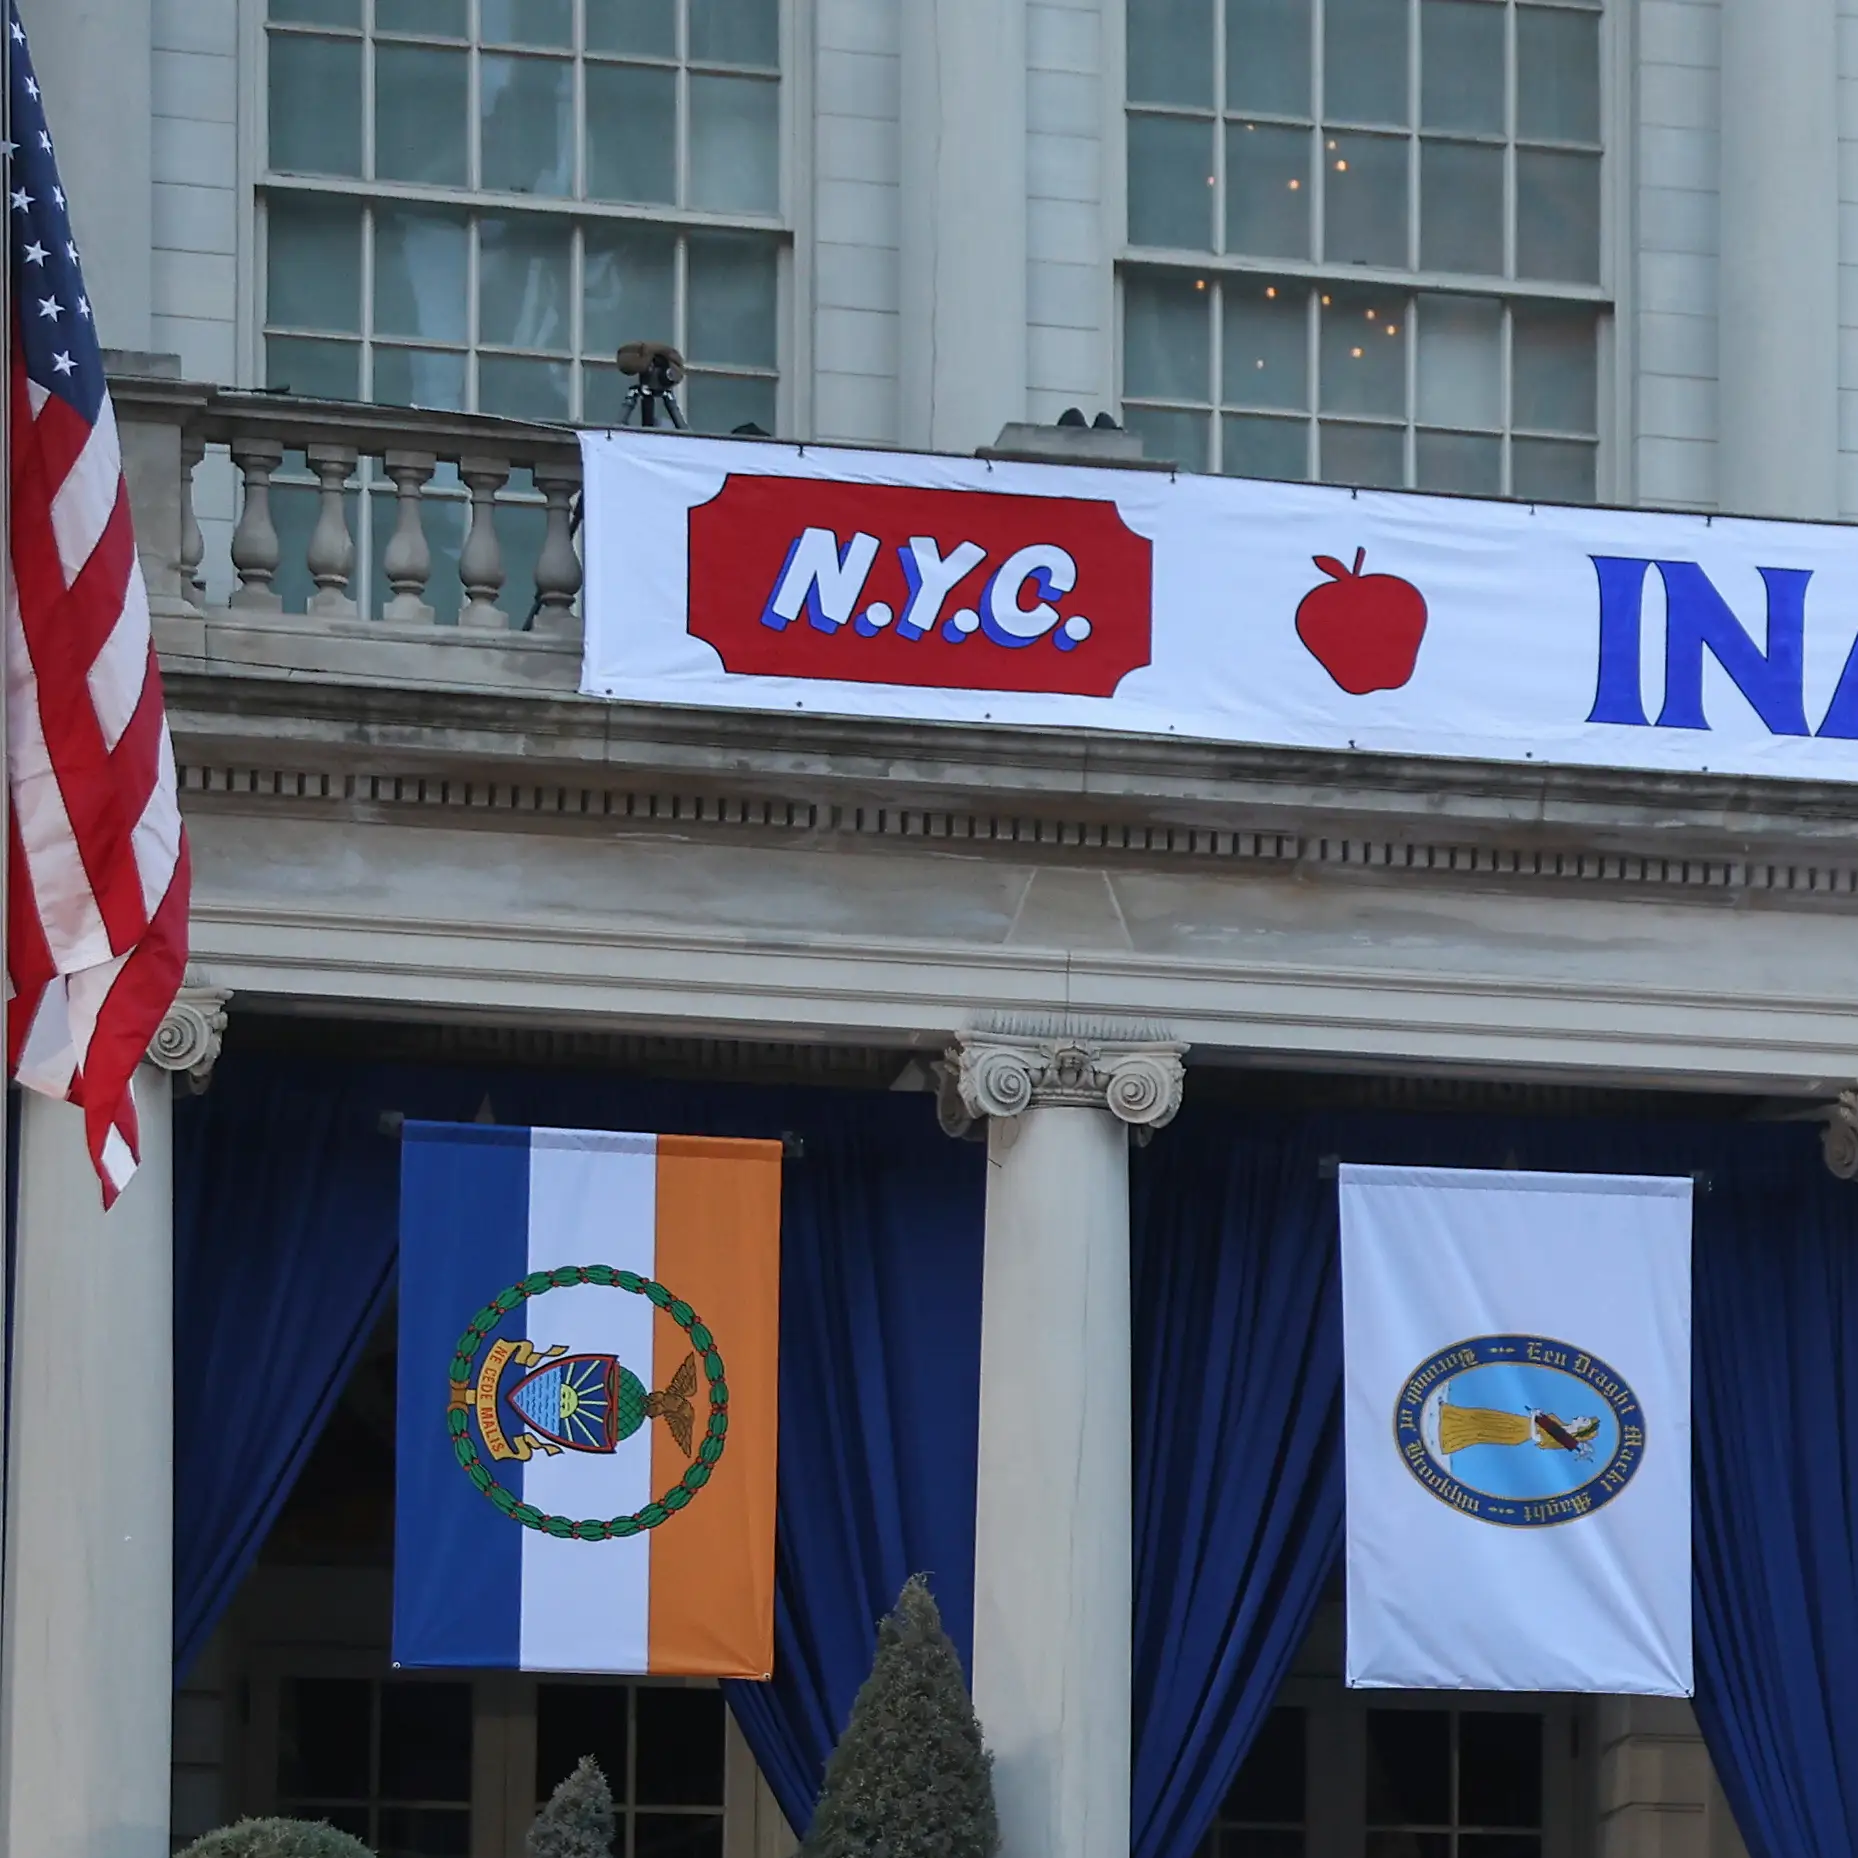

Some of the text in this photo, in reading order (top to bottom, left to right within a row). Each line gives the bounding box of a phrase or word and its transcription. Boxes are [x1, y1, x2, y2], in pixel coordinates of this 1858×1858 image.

[759, 526, 1093, 652] N.Y.C.
[480, 1345, 508, 1452] NE CEDE MALIS
